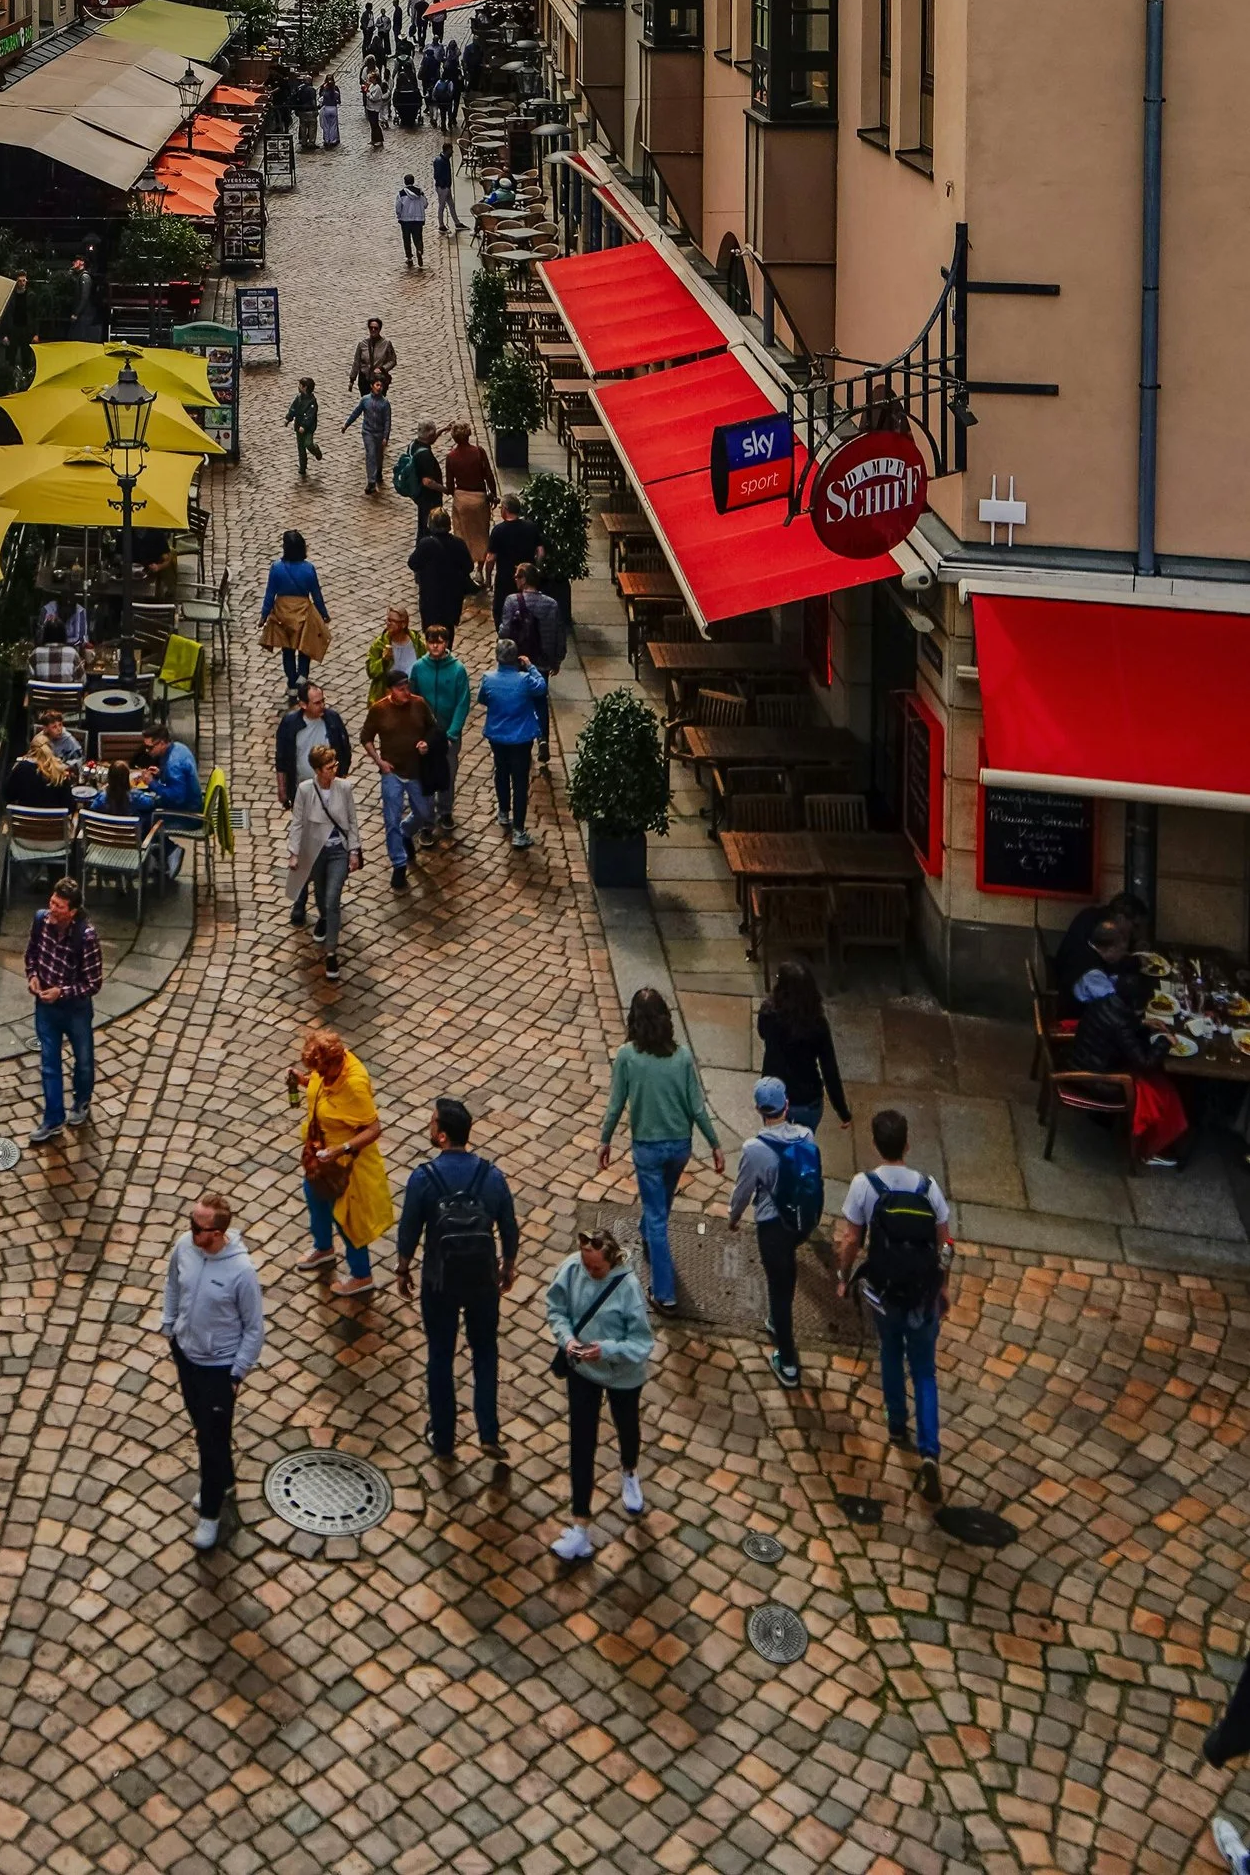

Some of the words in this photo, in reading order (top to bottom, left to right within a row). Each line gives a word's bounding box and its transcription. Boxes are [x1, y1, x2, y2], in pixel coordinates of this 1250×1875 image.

[742, 429, 775, 459] sky
[740, 471, 780, 495] sport
[848, 459, 905, 488] DAMPF
[826, 463, 922, 523] SCHIFF
